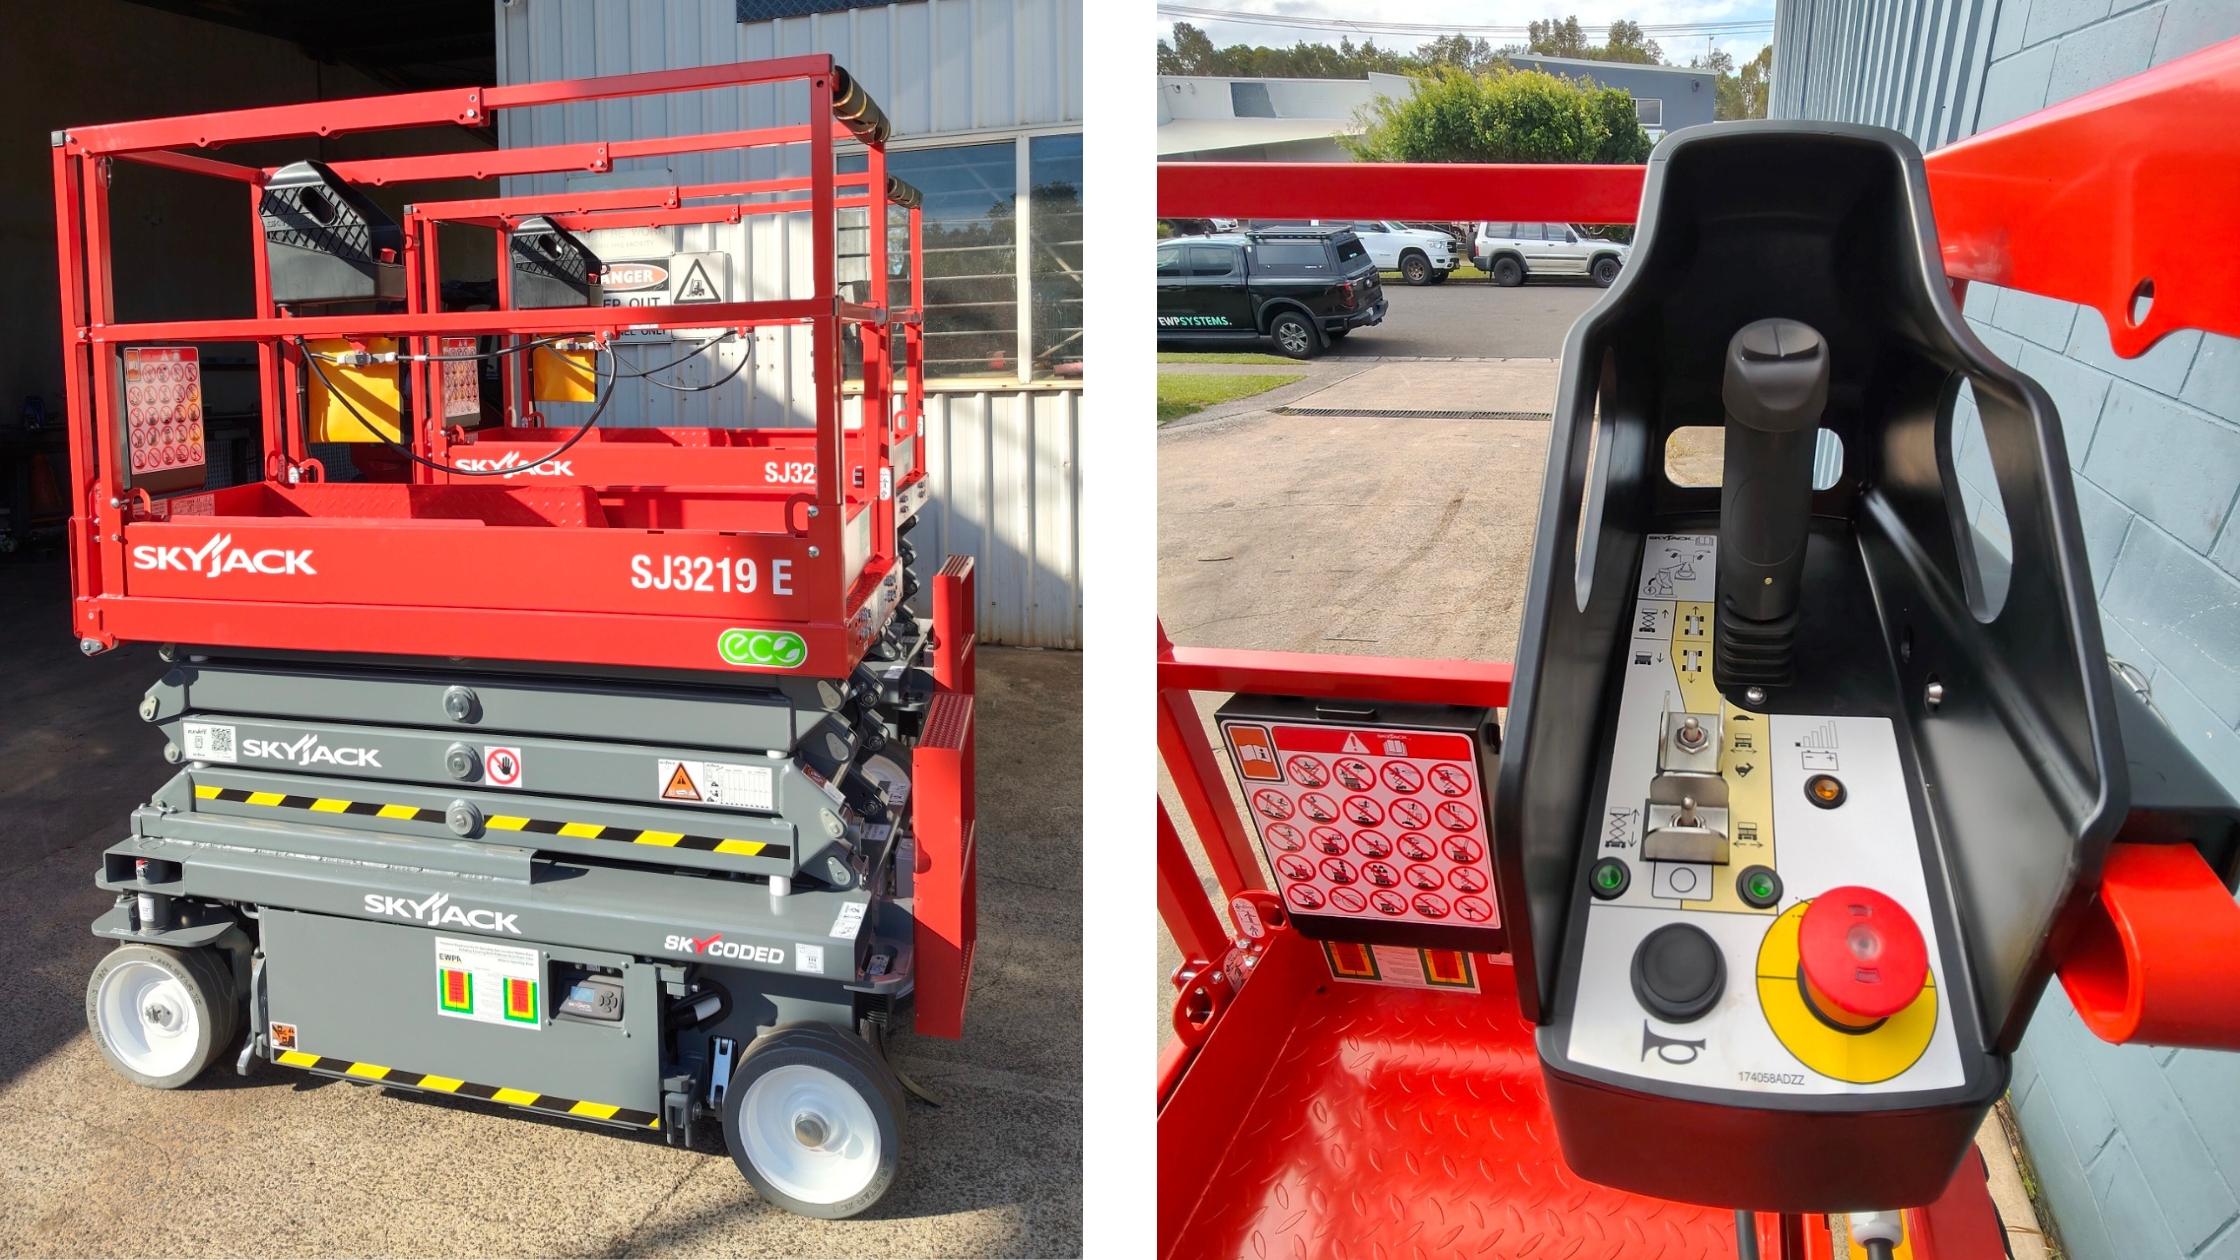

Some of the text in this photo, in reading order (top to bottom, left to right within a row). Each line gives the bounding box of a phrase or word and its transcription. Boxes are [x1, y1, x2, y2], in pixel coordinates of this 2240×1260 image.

[610, 230, 625, 239] BE
[601, 269, 654, 285] ANGER
[455, 450, 575, 479] SKYJACK
[764, 461, 817, 484] SJ32
[133, 532, 318, 579] SKYJACK
[630, 554, 793, 596] SJ3219 E
[724, 632, 801, 664] eco
[242, 733, 382, 768] SKYJACK
[364, 891, 522, 935] SKYJACK
[663, 932, 785, 965] SKYCODED
[1738, 1071, 1806, 1086] 174058ADZZ
